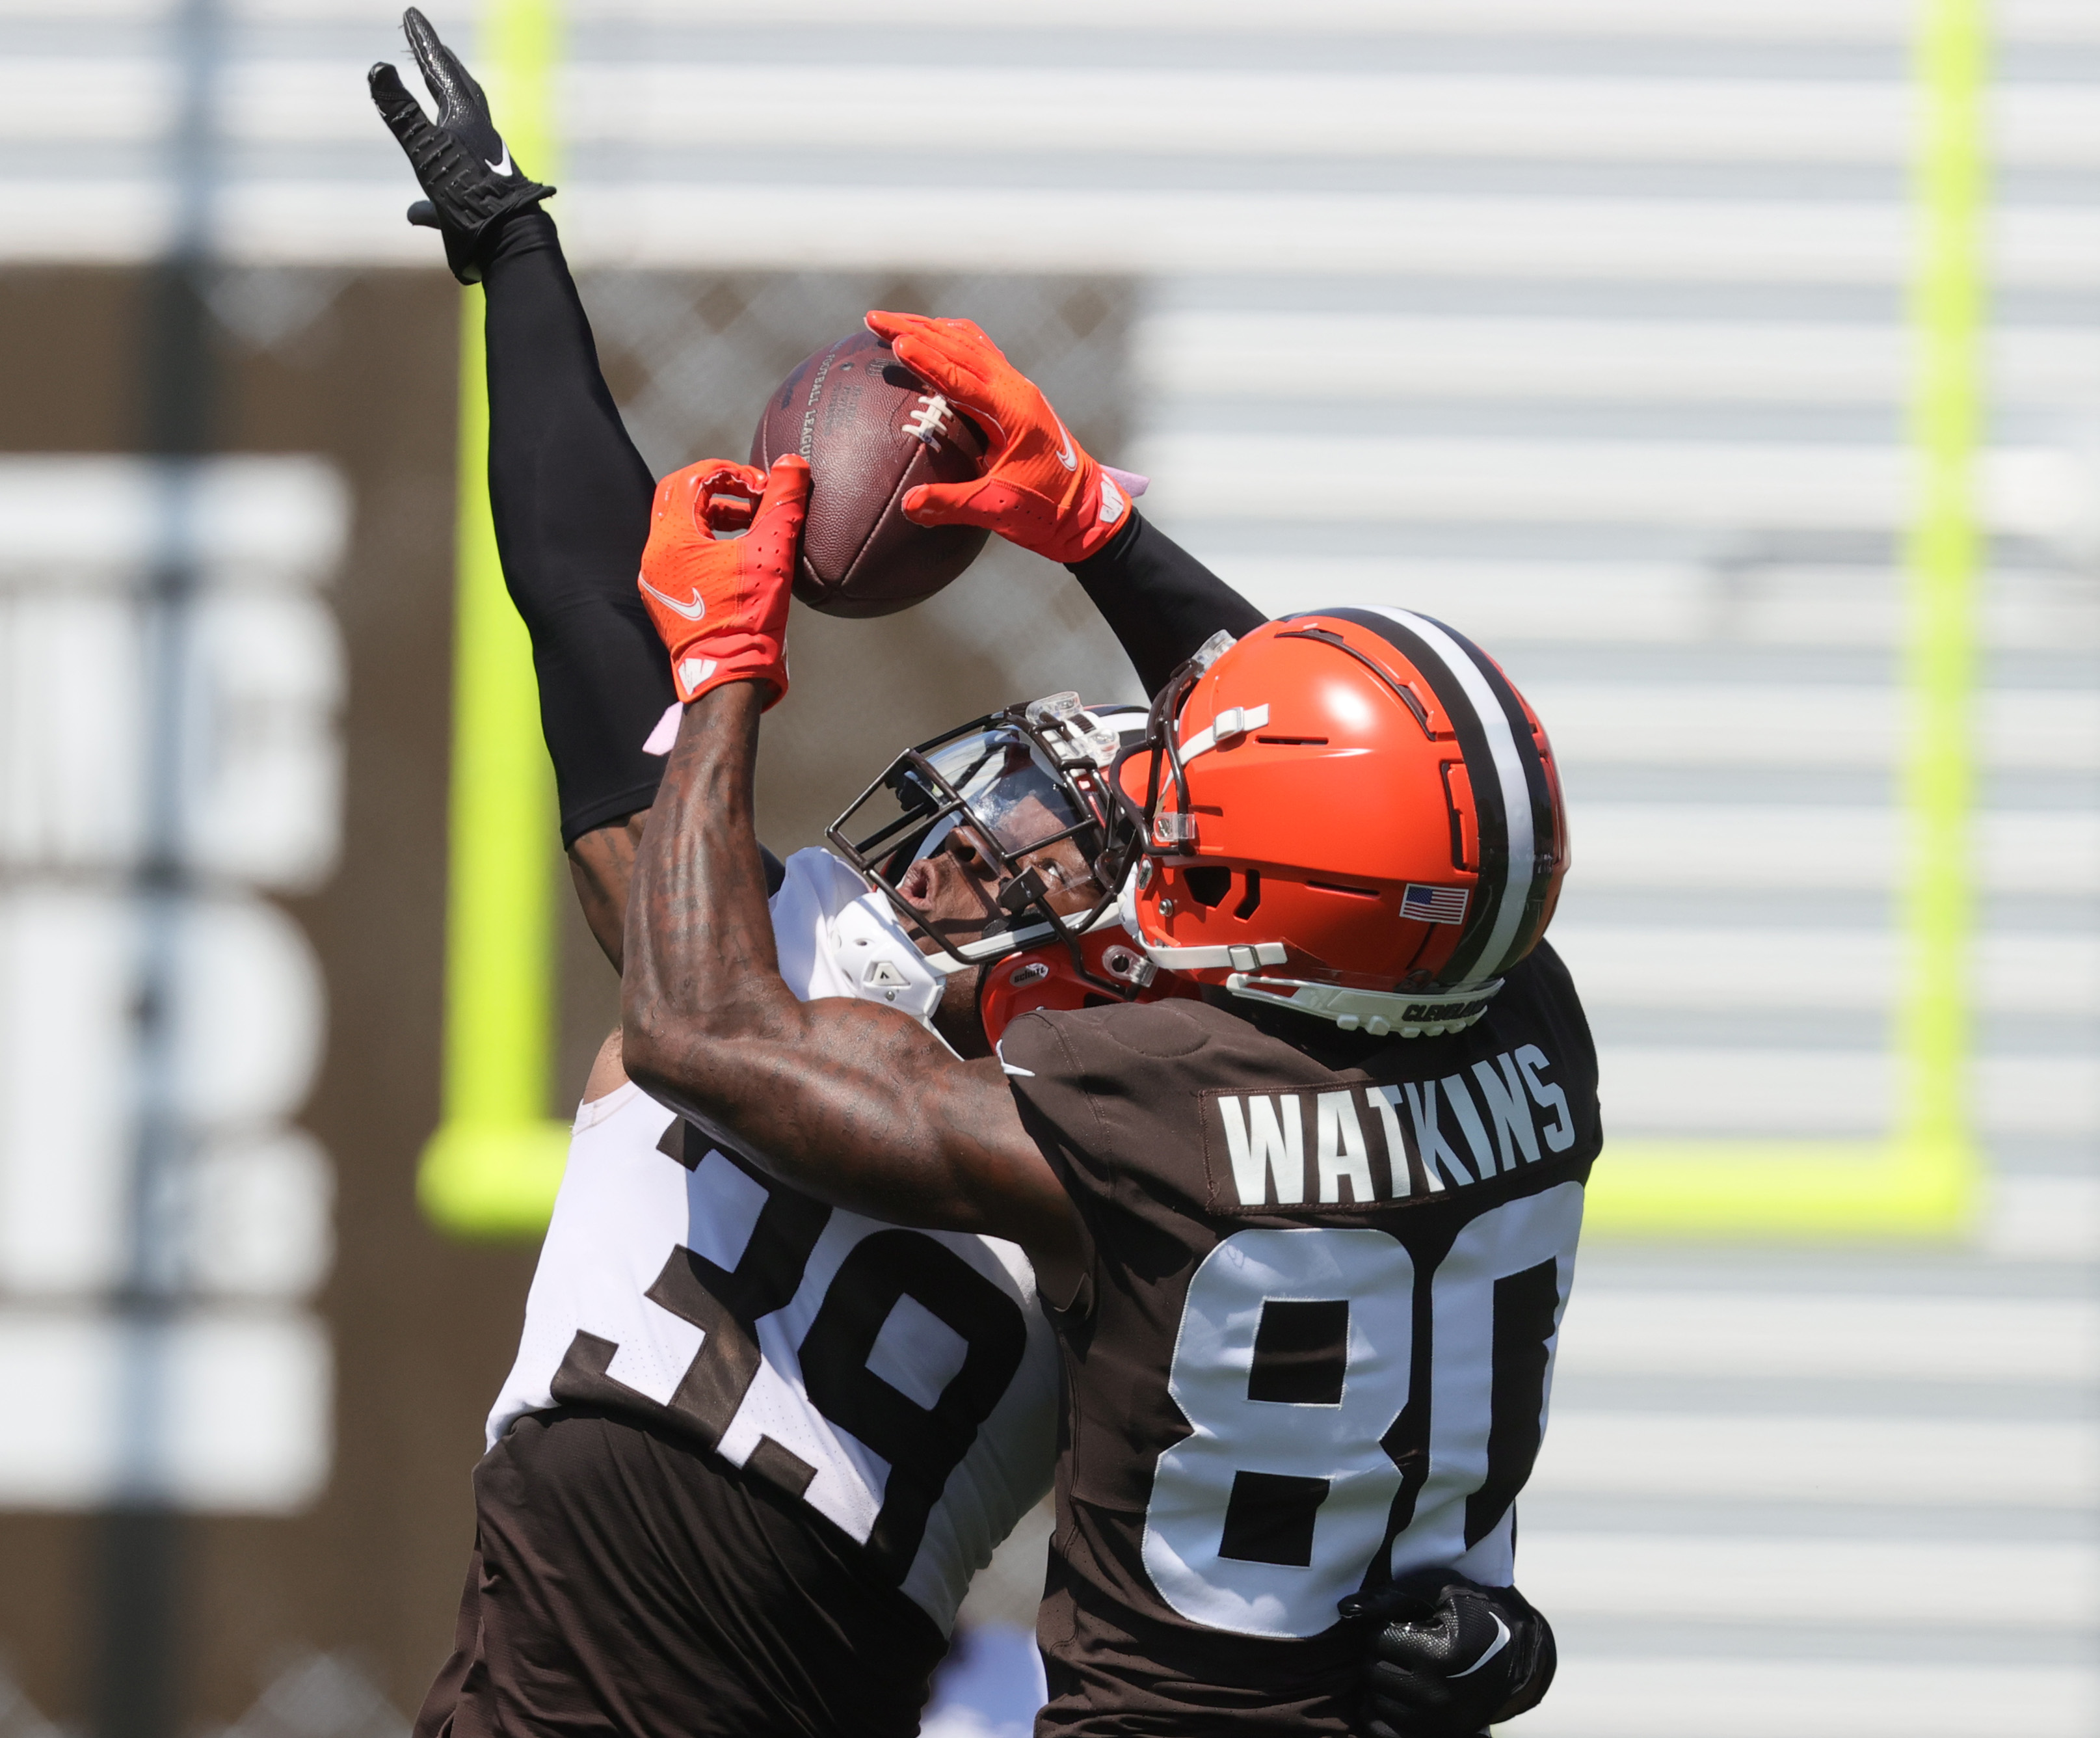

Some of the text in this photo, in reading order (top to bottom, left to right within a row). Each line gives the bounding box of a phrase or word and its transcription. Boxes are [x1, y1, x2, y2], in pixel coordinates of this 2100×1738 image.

[808, 354, 835, 407] FOOTBALL
[1402, 996, 1490, 1022] CLEVELAN
[1217, 1043, 1575, 1205] WATKINS
[1142, 1181, 1584, 1638] 80
